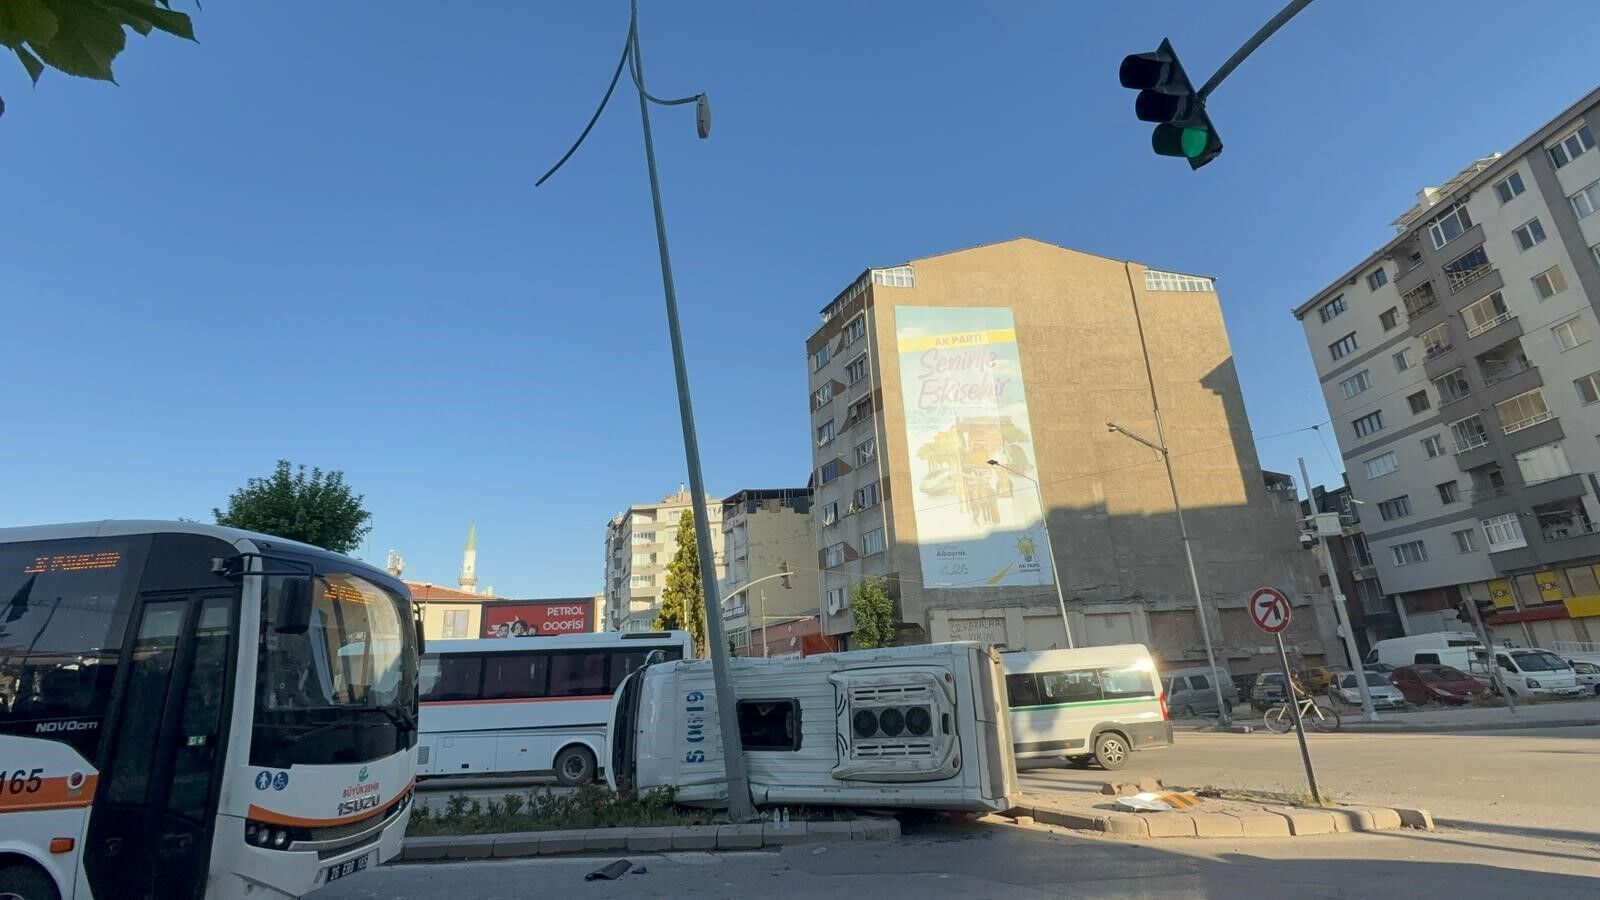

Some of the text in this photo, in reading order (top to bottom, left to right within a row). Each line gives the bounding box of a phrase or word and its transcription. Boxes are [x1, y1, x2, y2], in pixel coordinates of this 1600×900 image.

[935, 337, 949, 346] AK
[918, 348, 998, 379] Seninle
[547, 606, 584, 616] PETROL
[337, 794, 381, 816] ISUZU
